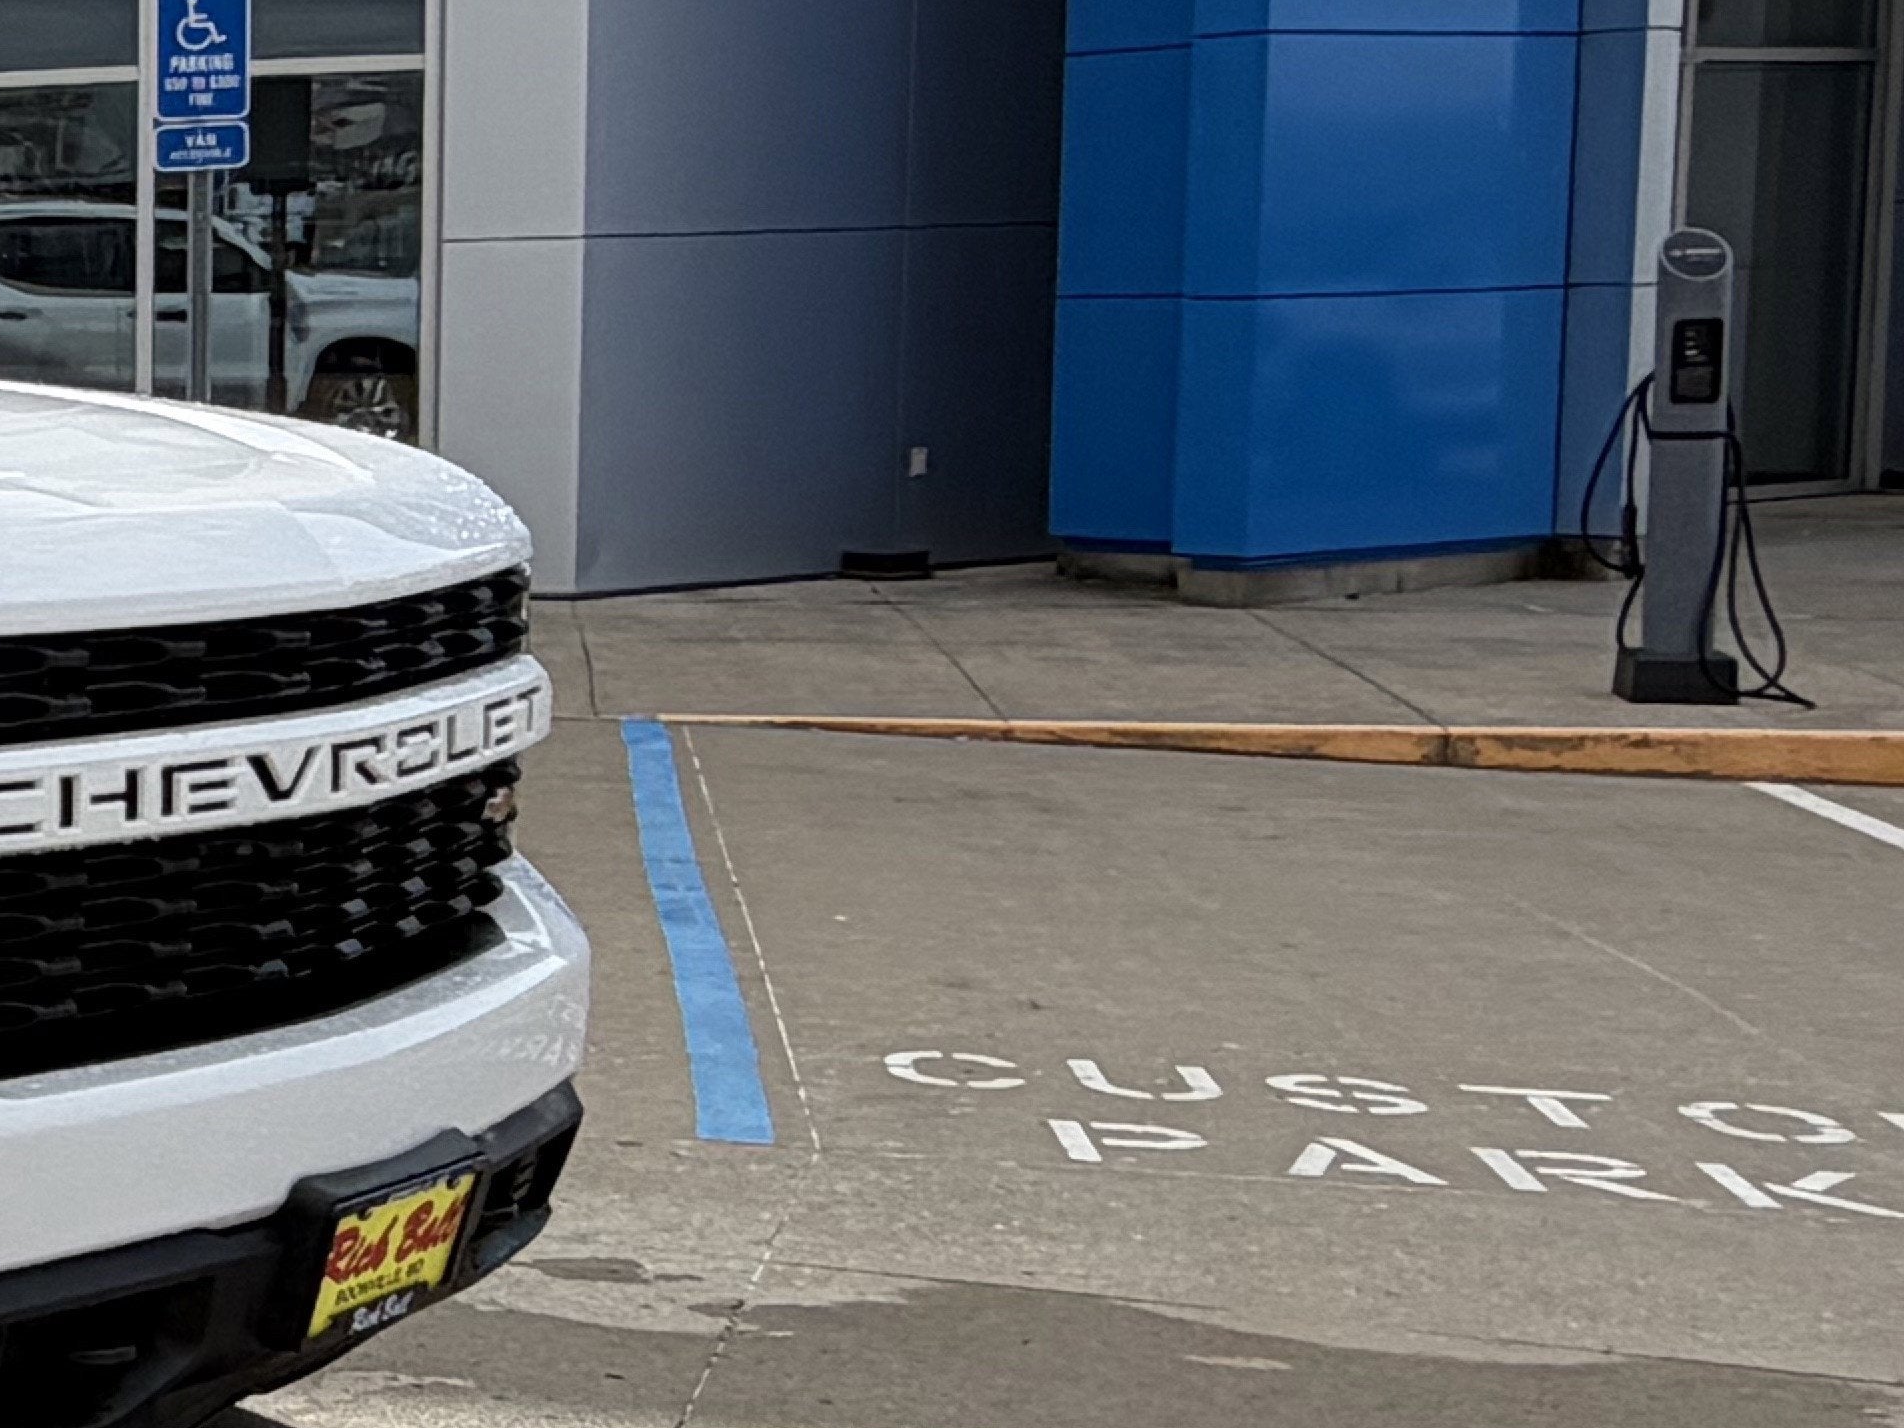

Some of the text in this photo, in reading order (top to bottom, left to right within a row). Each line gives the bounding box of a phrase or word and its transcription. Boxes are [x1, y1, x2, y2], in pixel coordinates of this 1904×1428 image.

[169, 52, 235, 74] PARKING
[325, 1196, 471, 1285] Rick Ball
